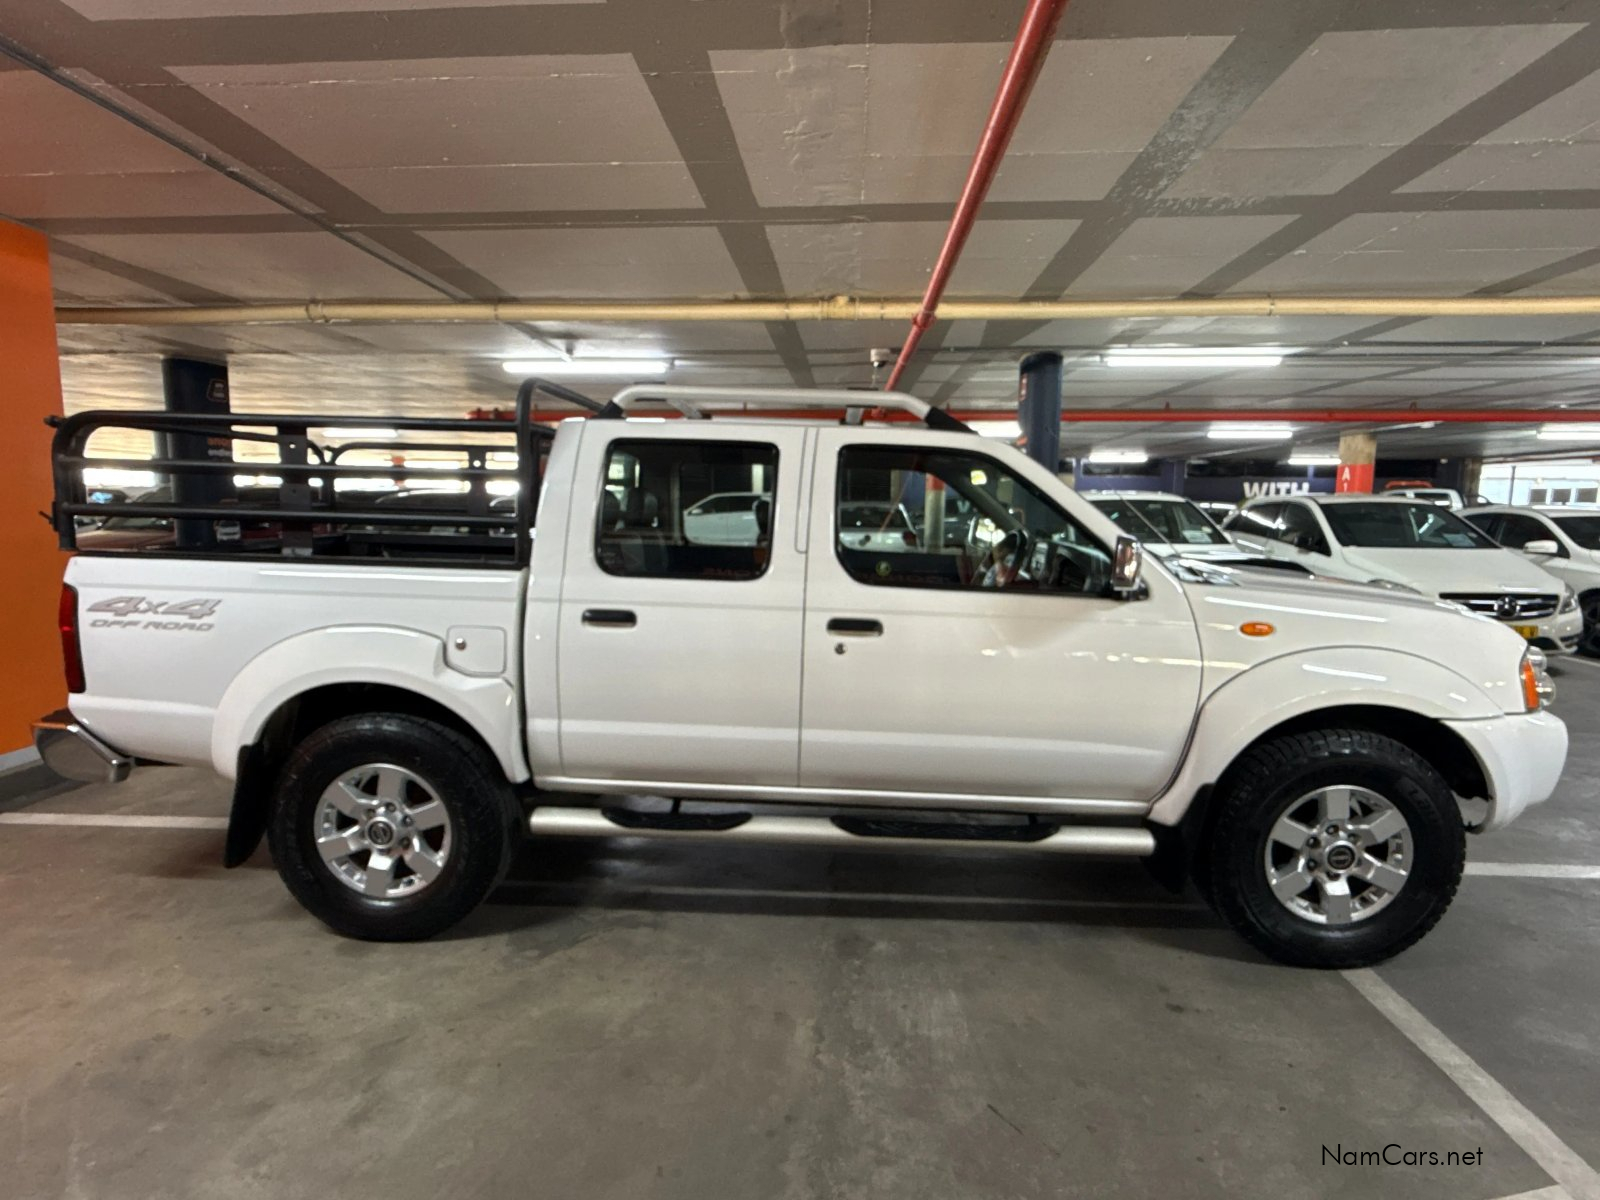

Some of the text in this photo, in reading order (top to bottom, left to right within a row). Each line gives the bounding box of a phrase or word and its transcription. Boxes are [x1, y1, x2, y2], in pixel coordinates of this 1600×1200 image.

[1341, 466, 1351, 481] A
[1243, 481, 1310, 497] WITH
[86, 596, 222, 620] 4x4
[90, 619, 214, 632] OFF ROAD
